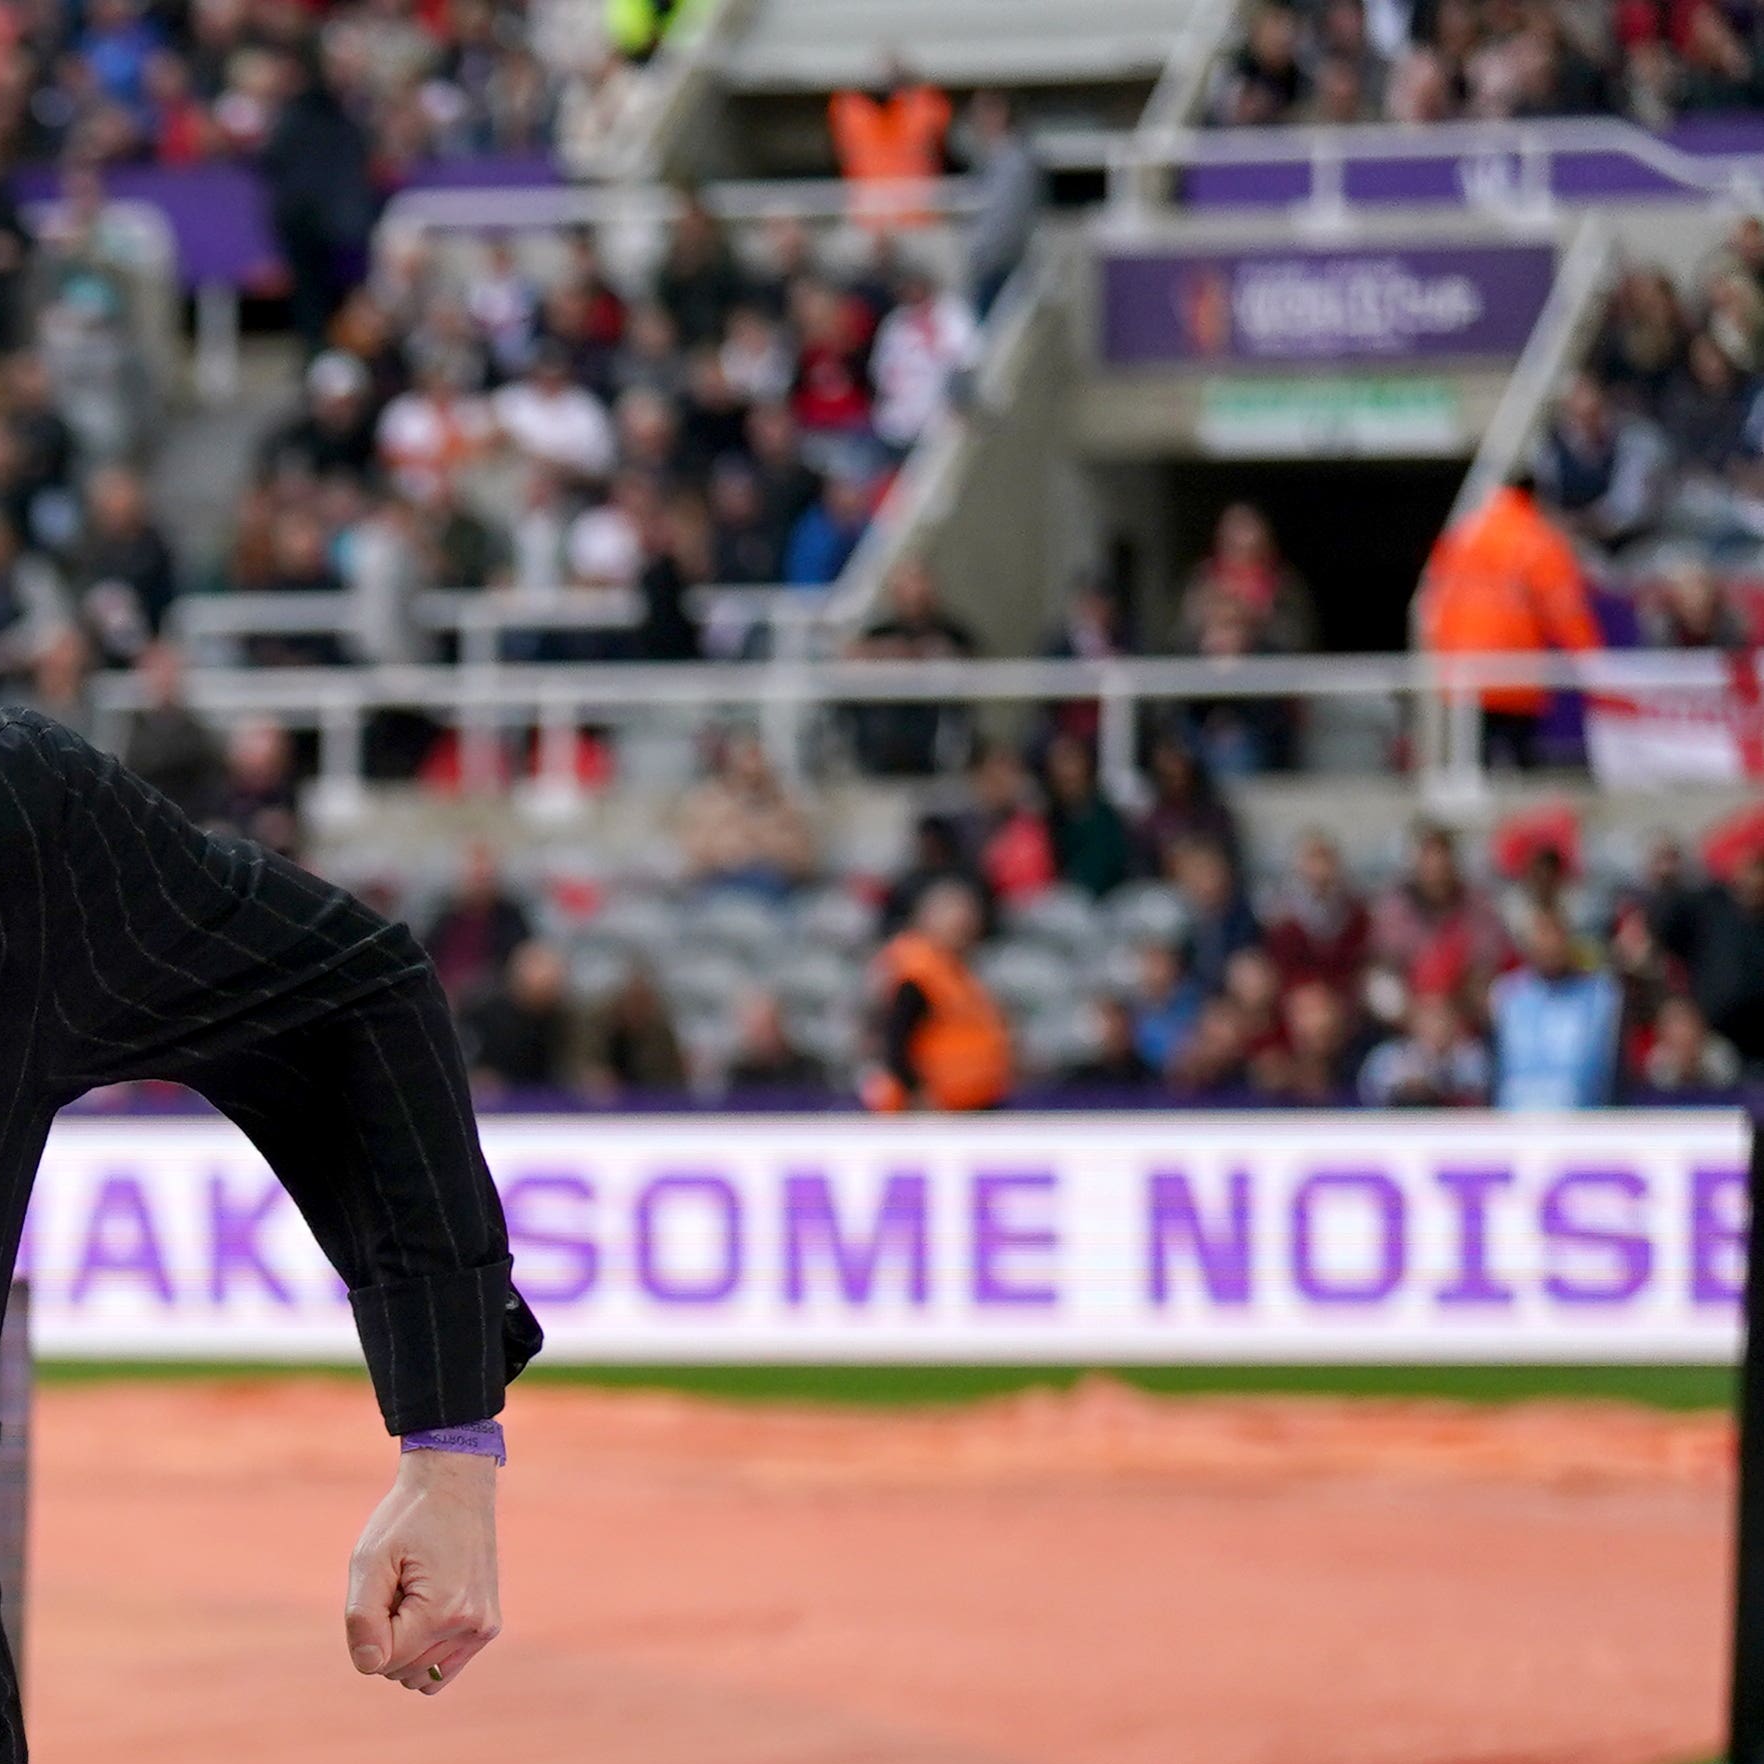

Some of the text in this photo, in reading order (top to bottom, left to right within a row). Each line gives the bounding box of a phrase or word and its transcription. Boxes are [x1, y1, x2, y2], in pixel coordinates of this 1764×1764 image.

[18, 1164, 1753, 1307] AK SOME NOISE
[432, 1433, 478, 1448] SPORTS
